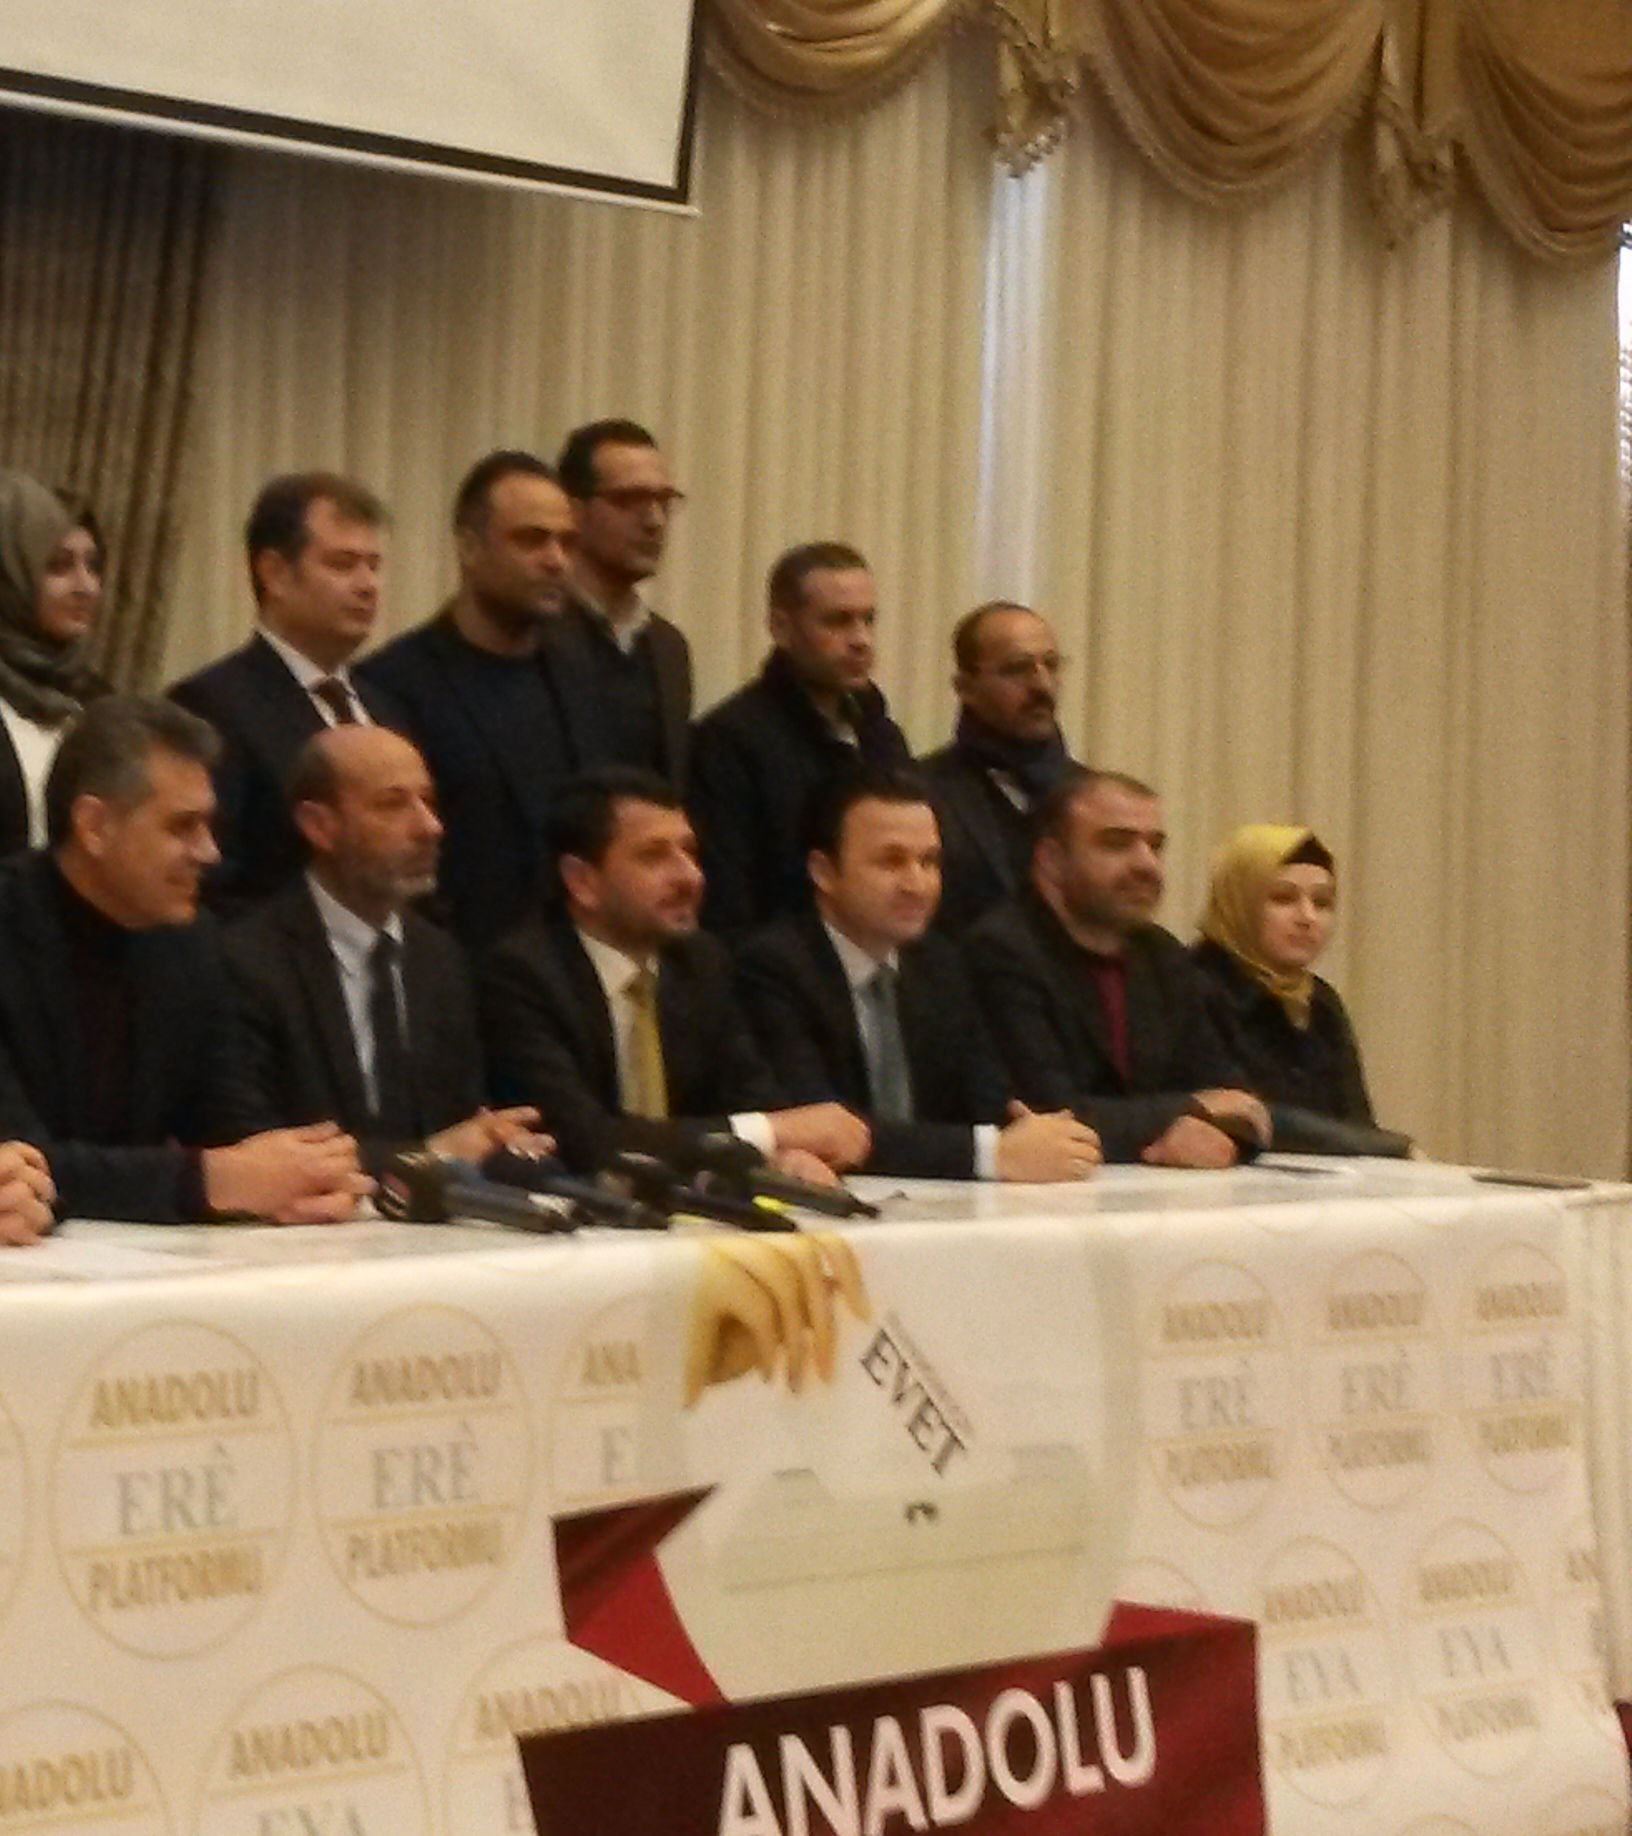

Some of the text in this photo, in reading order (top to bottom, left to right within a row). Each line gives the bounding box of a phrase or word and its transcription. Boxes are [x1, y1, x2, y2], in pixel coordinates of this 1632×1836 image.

[88, 1367, 261, 1430] ANADOLU
[347, 1350, 502, 1406] ANADOLU
[859, 1328, 965, 1477] EVET
[116, 1440, 239, 1537] ERÊ
[372, 1417, 480, 1509] ERÊ
[87, 1544, 264, 1613] PLATFORMU
[346, 1518, 503, 1580] PLATFORMU
[228, 1710, 390, 1779] ANADOLU
[716, 1666, 1158, 1836] ANADOLU
